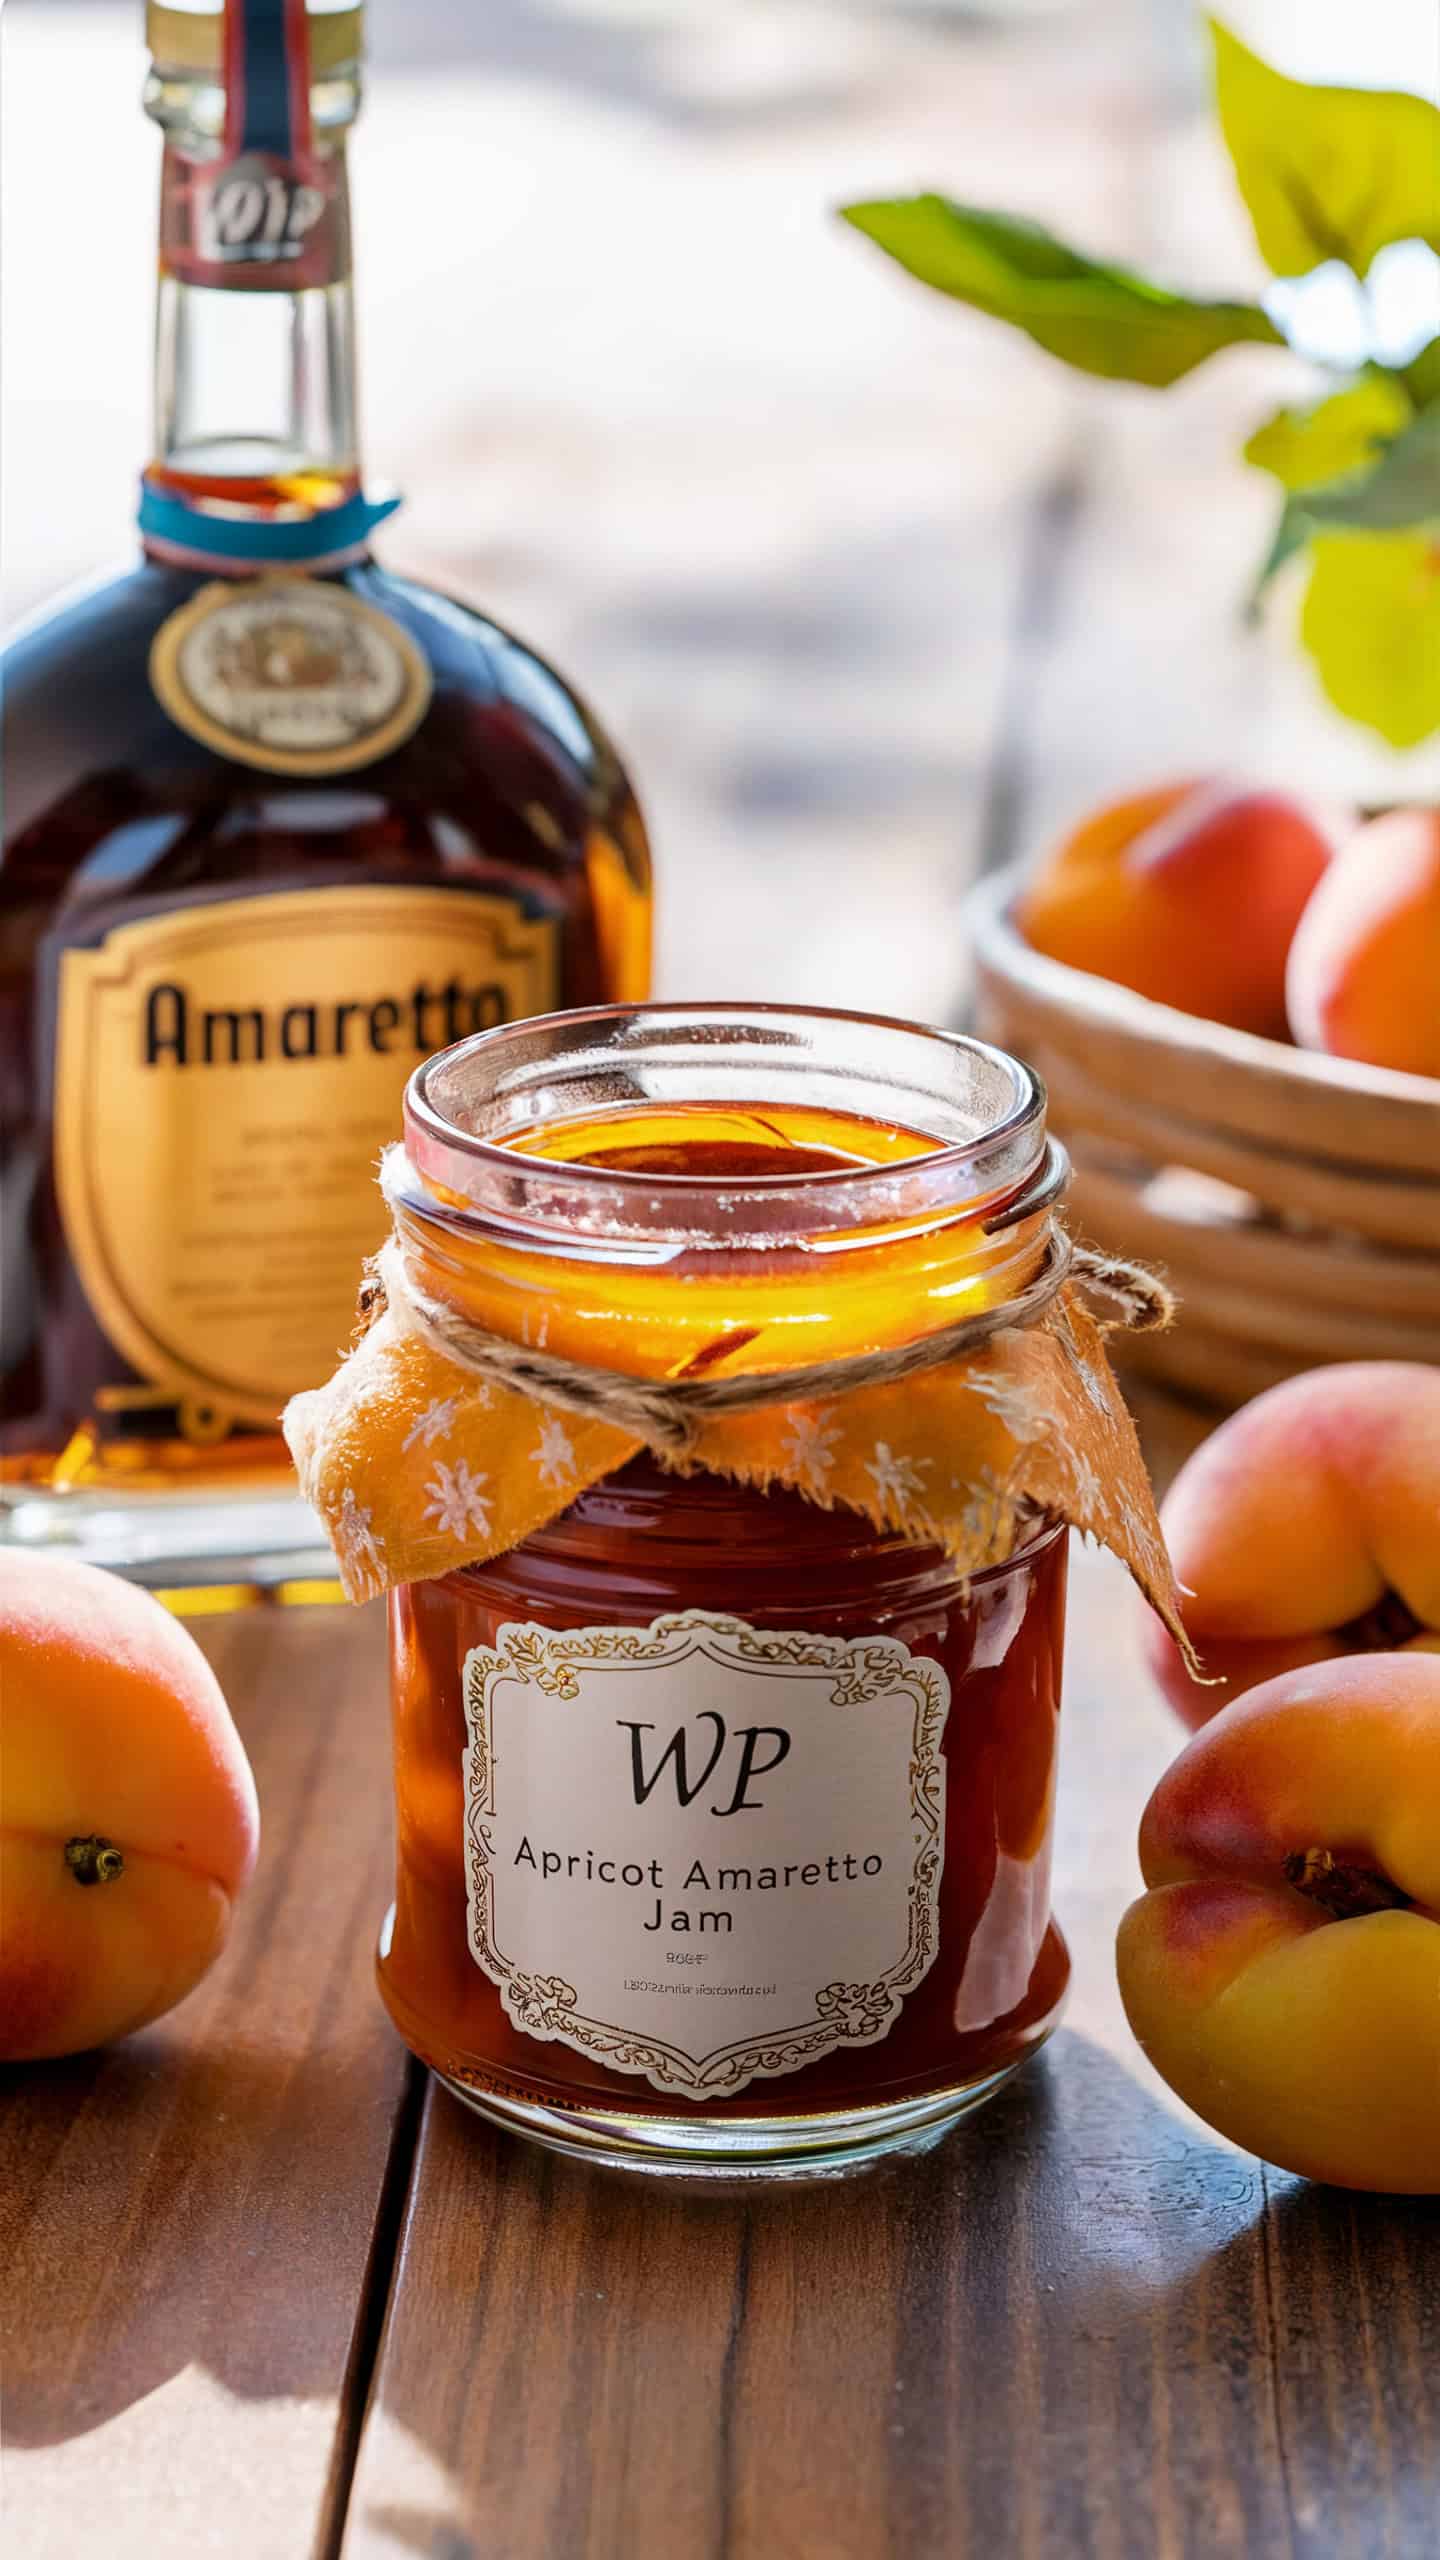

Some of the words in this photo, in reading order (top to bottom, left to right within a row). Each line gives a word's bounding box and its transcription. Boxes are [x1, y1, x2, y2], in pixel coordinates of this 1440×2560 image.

[146, 981, 507, 1065] Amaretto
[616, 1711, 791, 1816] WP
[514, 1836, 664, 1889] Apricot
[683, 1853, 883, 1891] Amaretto
[643, 1899, 733, 1933] Jam
